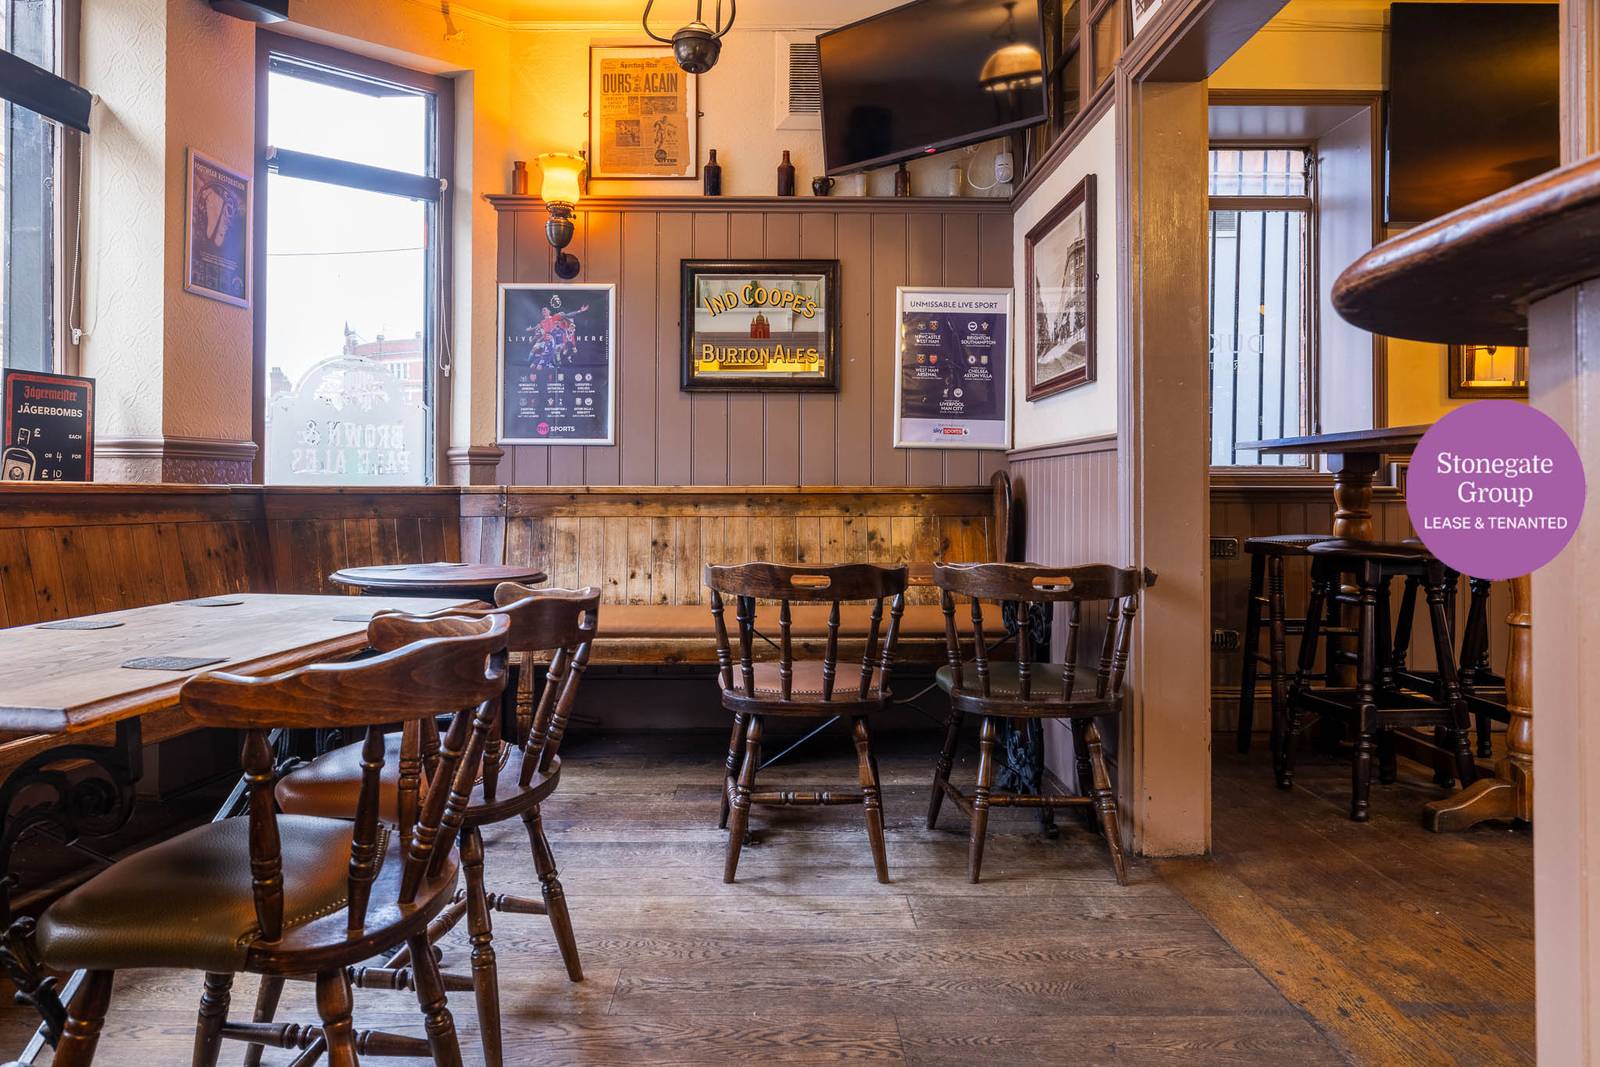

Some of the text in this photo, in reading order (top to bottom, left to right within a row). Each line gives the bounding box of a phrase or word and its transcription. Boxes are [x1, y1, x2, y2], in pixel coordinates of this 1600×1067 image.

[602, 73, 632, 93] OURS
[643, 72, 678, 93] AGAIN
[703, 284, 817, 319] IND COOPE'S
[910, 301, 956, 309] UNMISSABLE
[702, 343, 818, 363] BURTON ALES
[17, 403, 83, 418] JÄGERBOMBS
[34, 428, 40, 437] £
[42, 469, 48, 478] £
